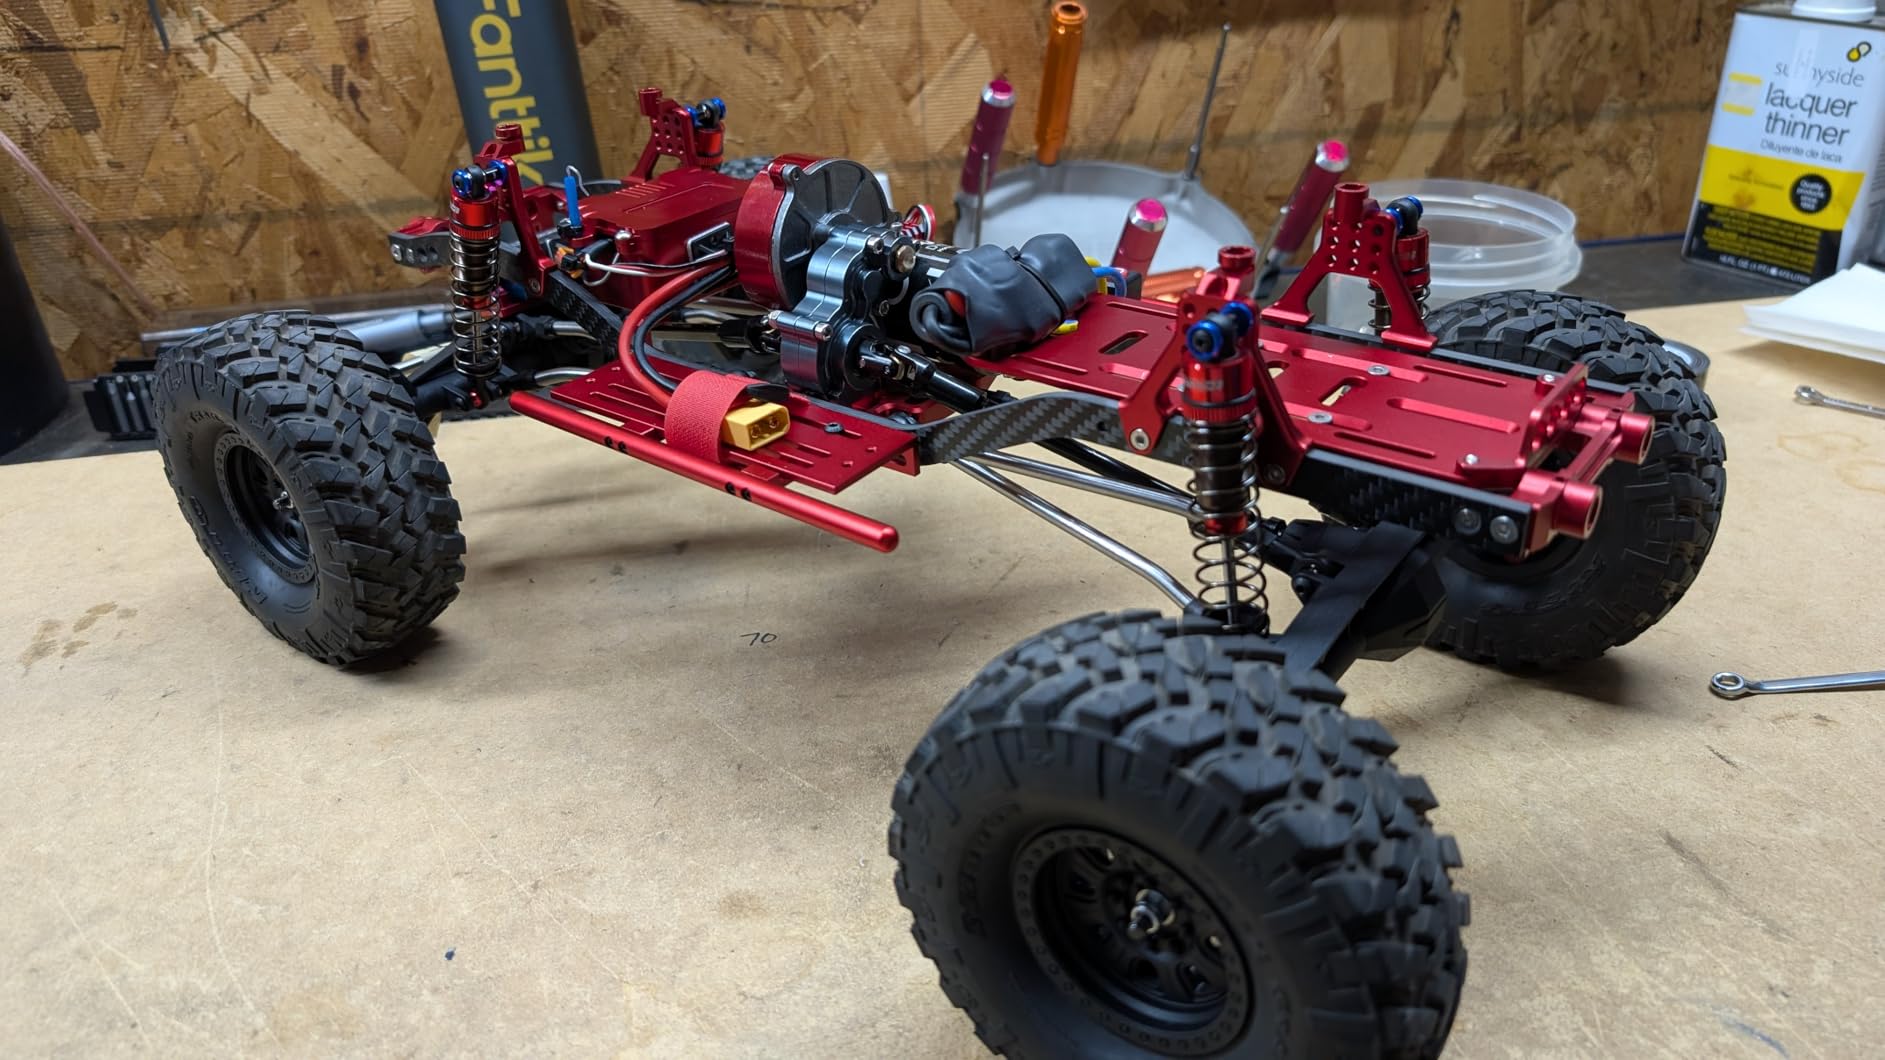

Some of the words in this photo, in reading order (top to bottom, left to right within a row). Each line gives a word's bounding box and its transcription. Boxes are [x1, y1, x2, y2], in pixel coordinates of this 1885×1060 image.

[470, 0, 553, 185] anttik
[1765, 82, 1858, 118] lacquer
[1765, 112, 1850, 146] thinner
